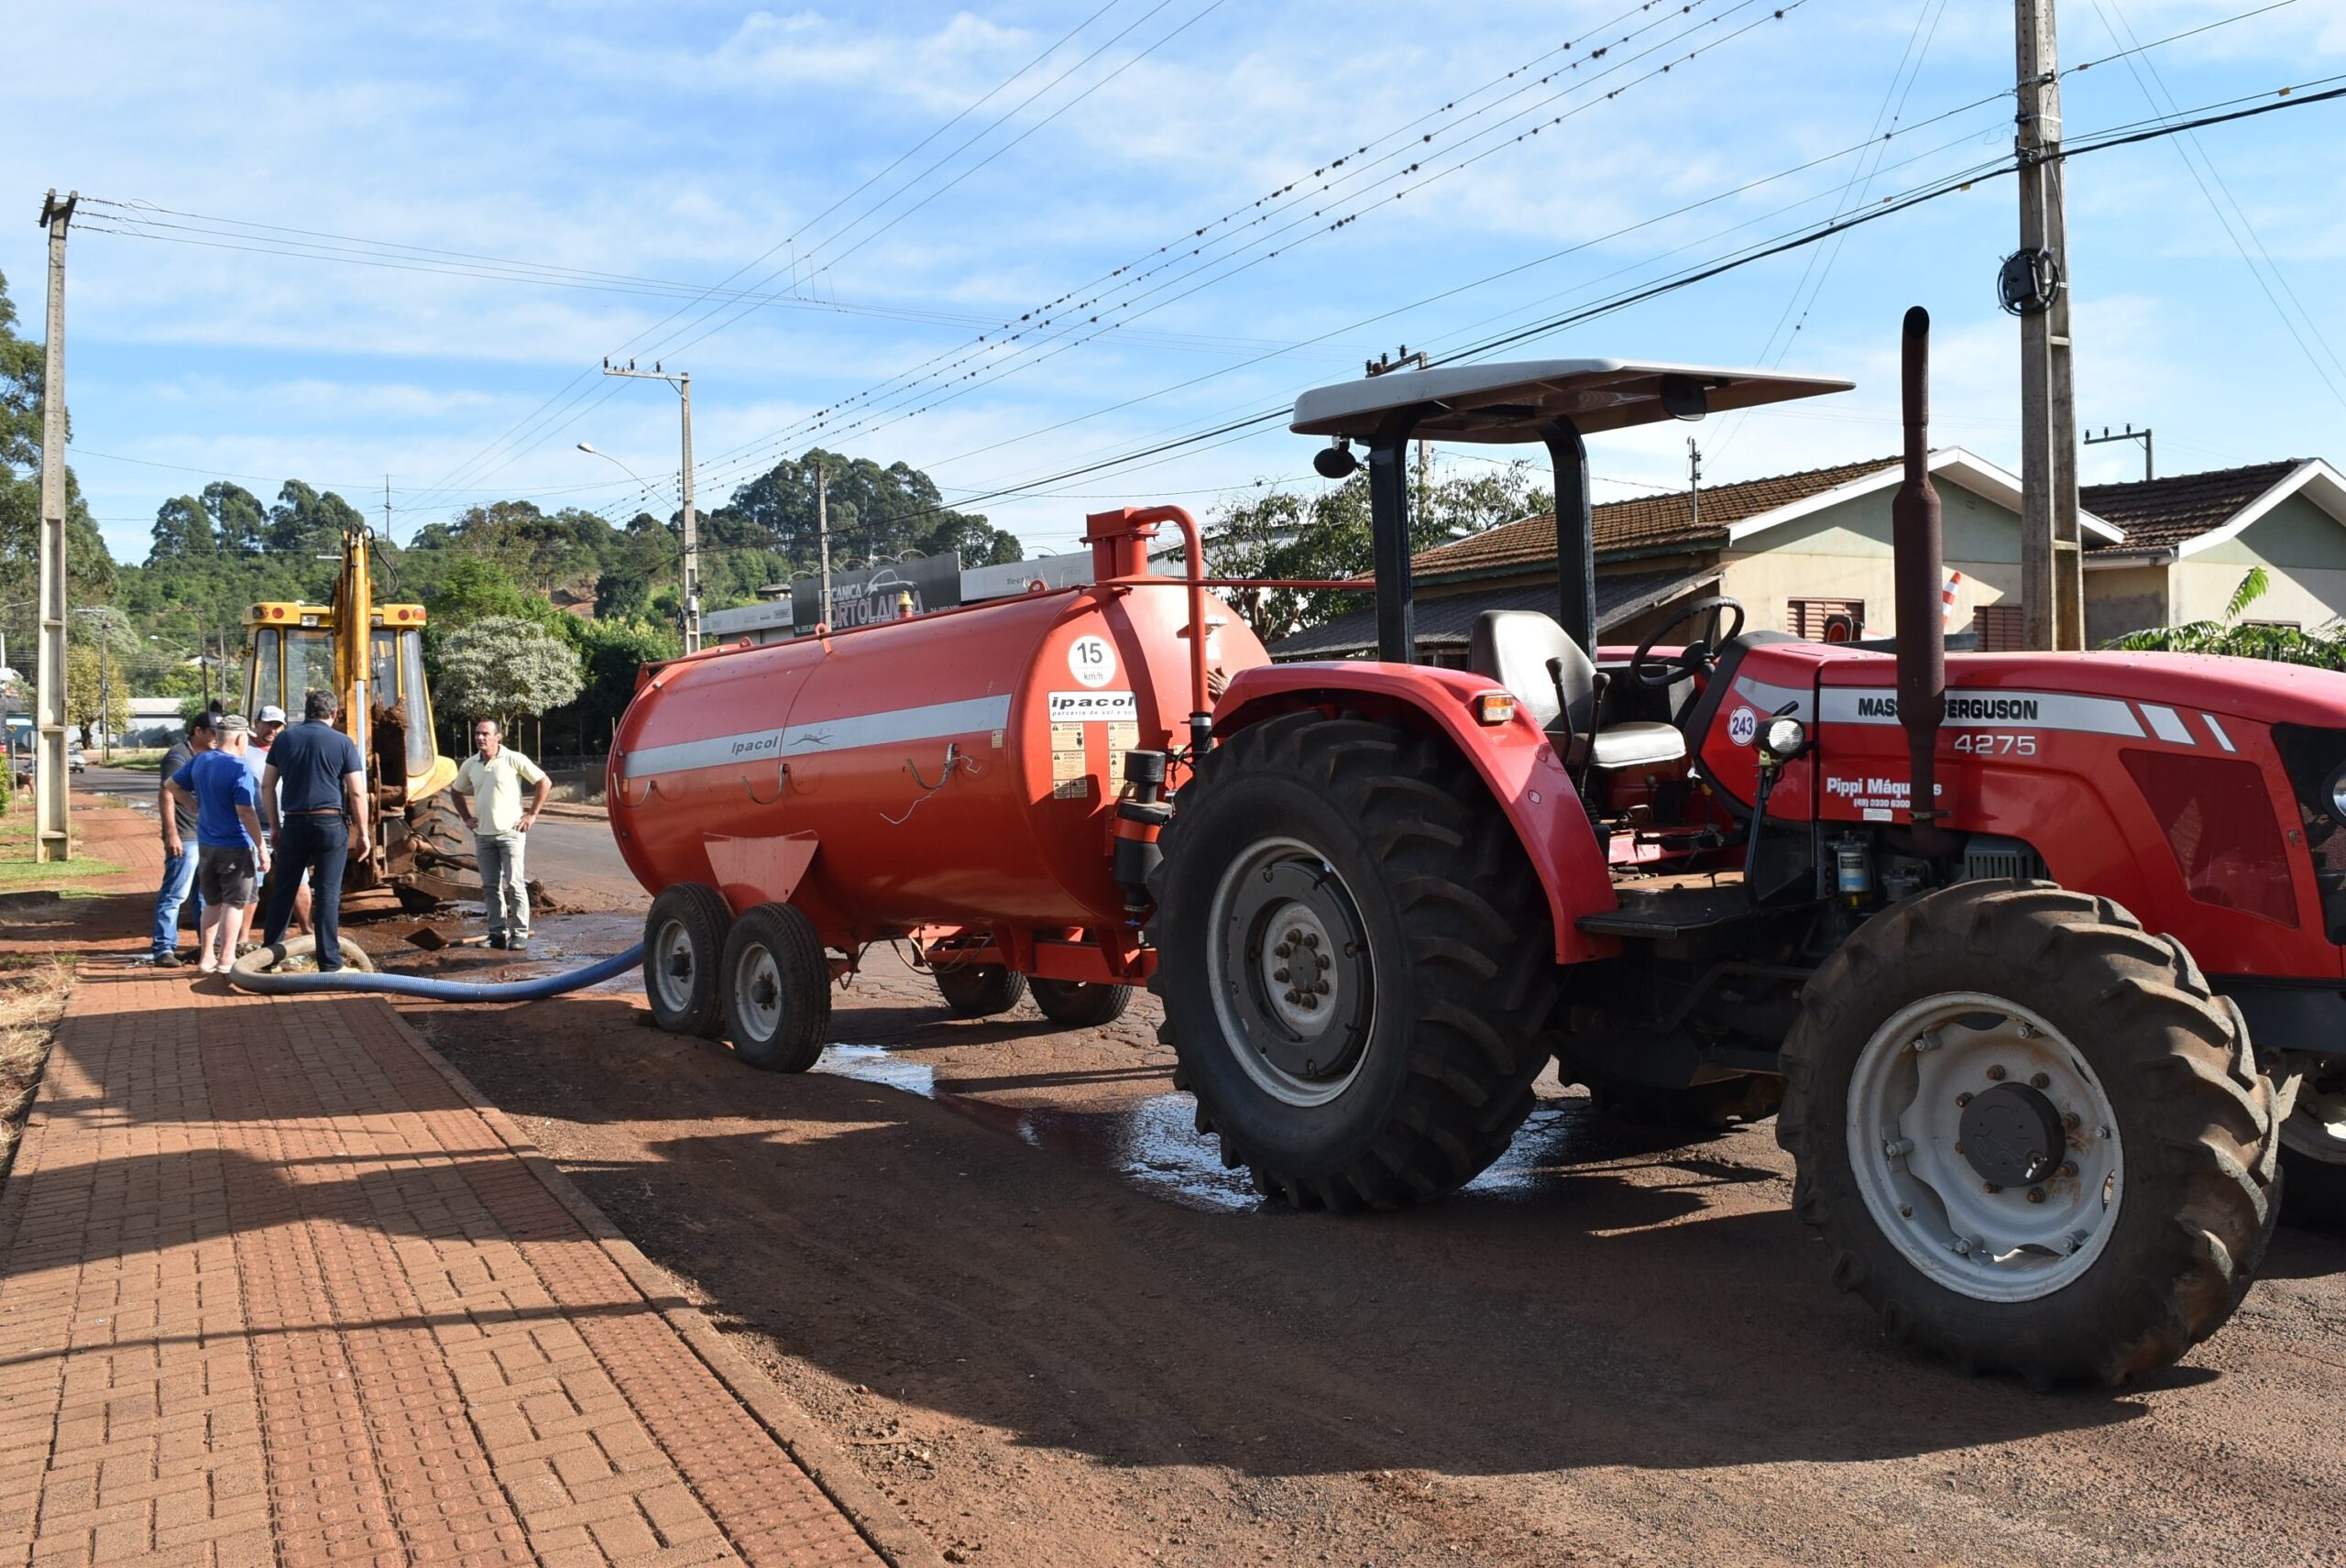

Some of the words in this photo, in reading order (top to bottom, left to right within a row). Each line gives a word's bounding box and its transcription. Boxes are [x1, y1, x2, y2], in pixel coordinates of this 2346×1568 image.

[819, 590, 924, 629] ORTOLANA
[1077, 642, 1102, 663] 15
[1083, 672, 1103, 681] km/h
[1052, 696, 1135, 710] ipacol
[1945, 698, 2039, 720] ERGUSON
[1731, 716, 1753, 736] 243
[731, 736, 779, 756] ipacol
[1954, 734, 2037, 756] 4275
[1826, 777, 1863, 797] Pippi
[1867, 778, 1943, 799] Máqus
